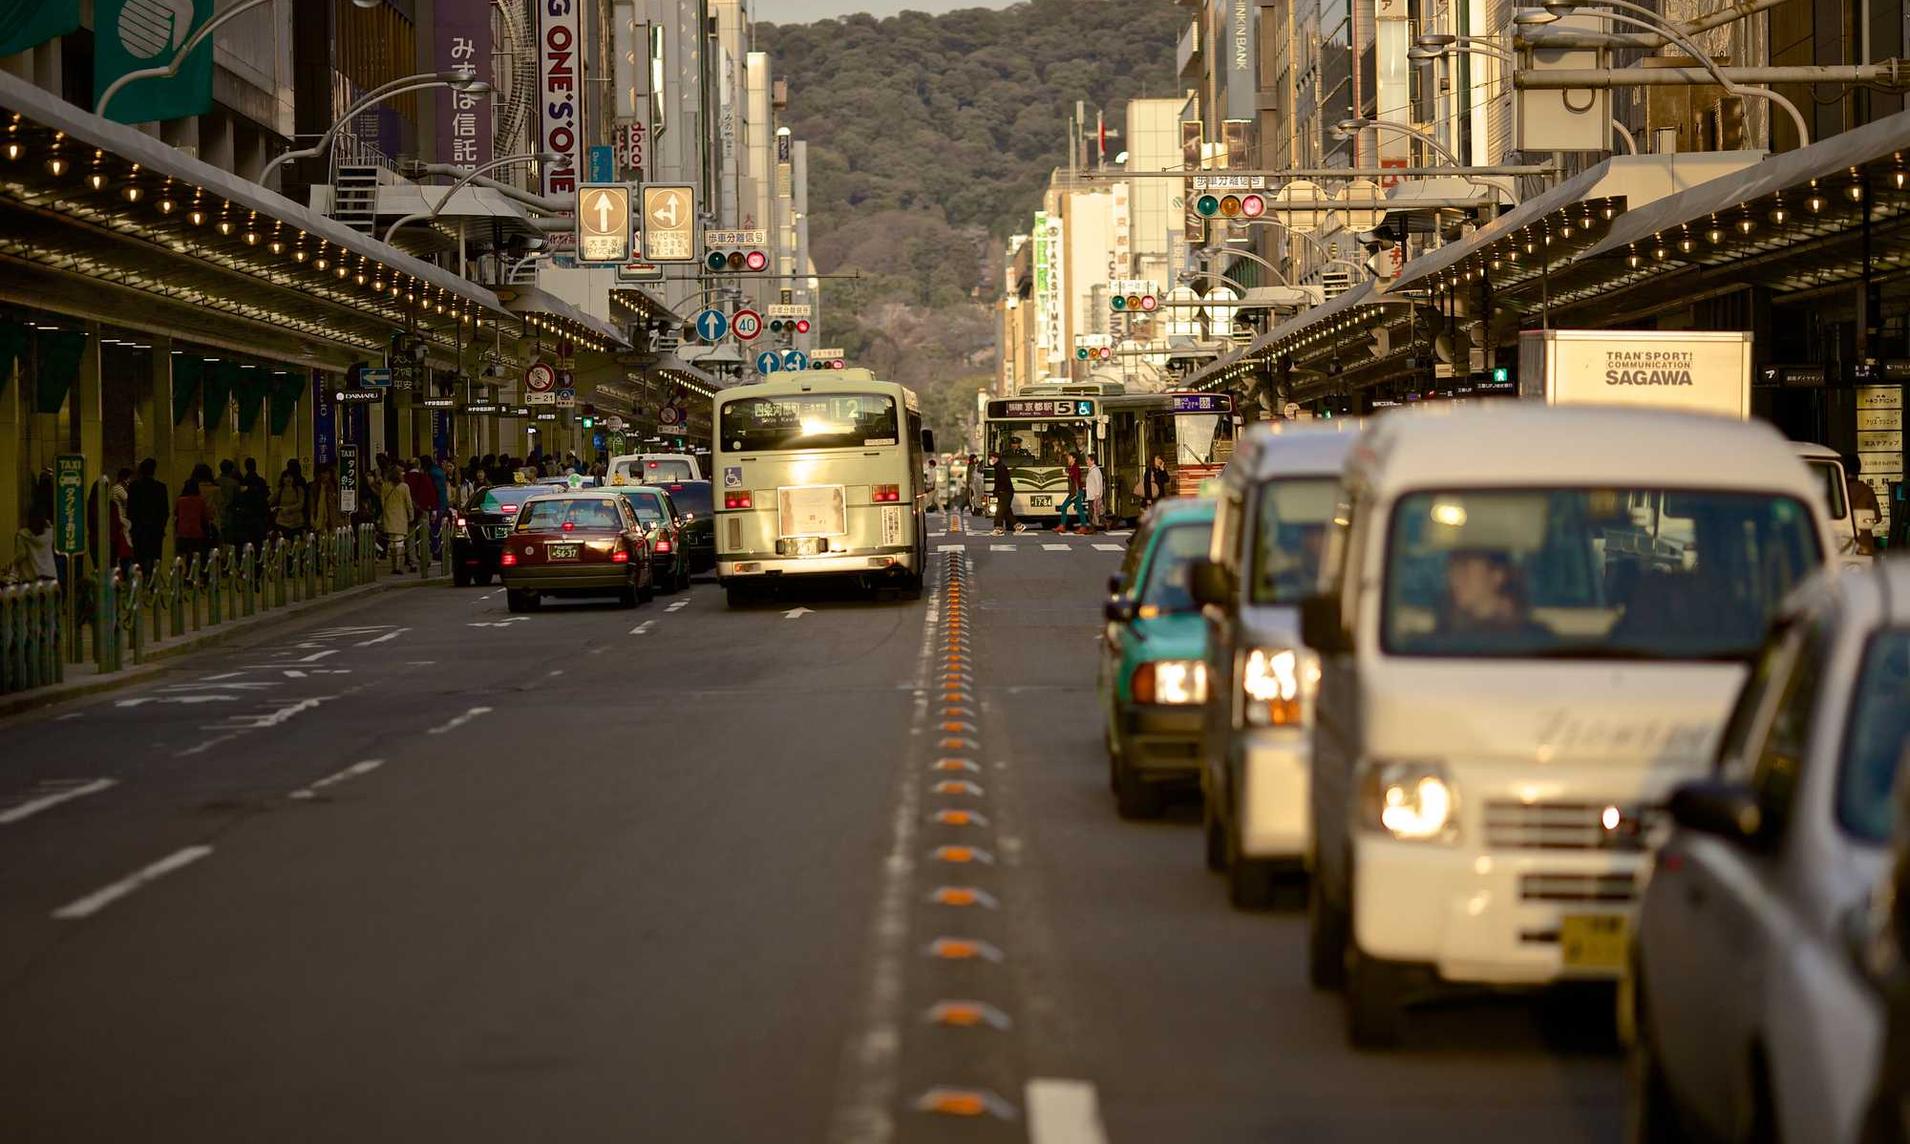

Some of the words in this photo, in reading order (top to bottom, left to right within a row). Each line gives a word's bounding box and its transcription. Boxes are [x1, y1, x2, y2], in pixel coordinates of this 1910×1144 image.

[1236, 37, 1248, 71] BANK
[1049, 240, 1059, 352] TAKASHIMAYA
[738, 318, 755, 331] 40
[1607, 360, 1691, 369] COMMUNICATION
[1605, 369, 1693, 386] SAGAWA
[1057, 402, 1071, 413] 5
[60, 460, 81, 471] TAXI
